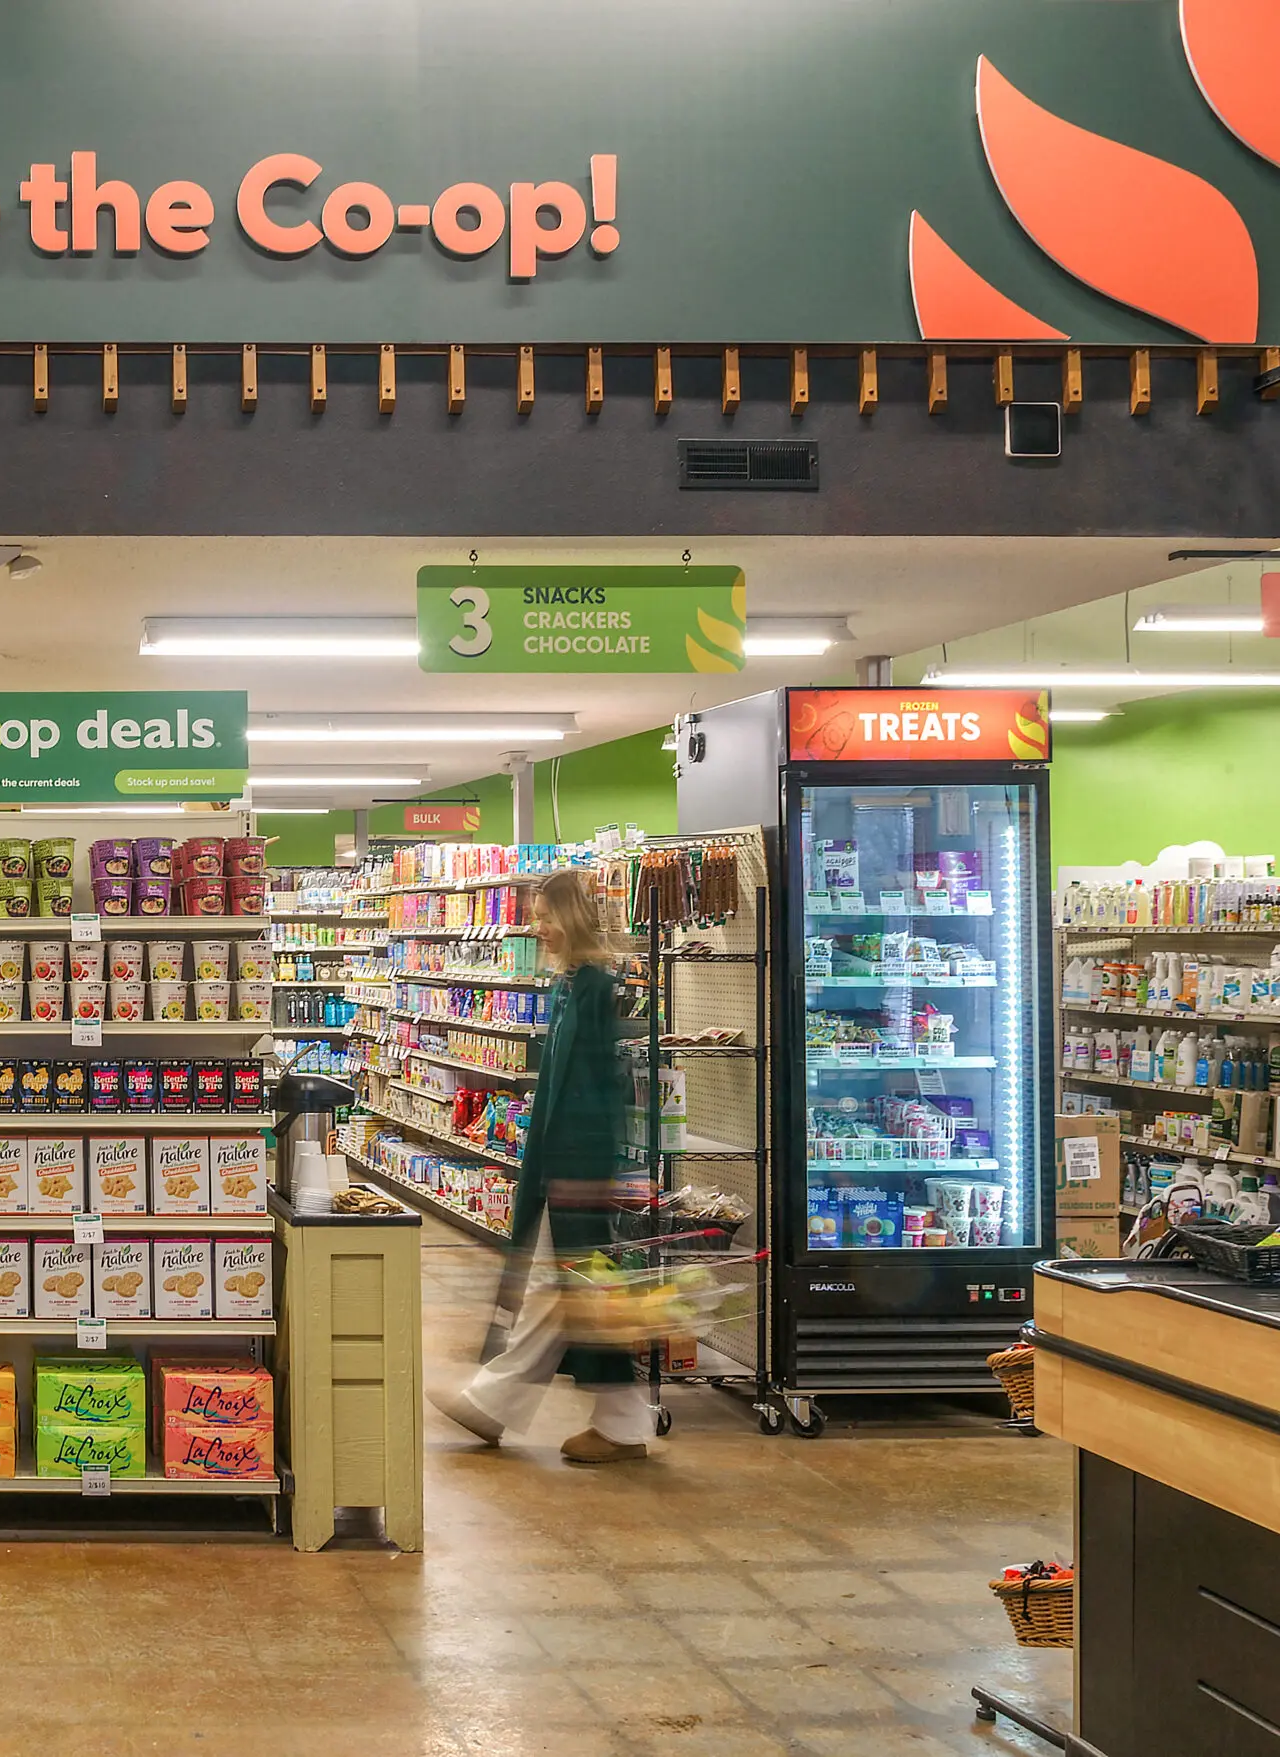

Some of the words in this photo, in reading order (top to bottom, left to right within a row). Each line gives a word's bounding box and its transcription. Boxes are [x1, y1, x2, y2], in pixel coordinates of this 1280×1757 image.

[20, 150, 216, 253] the
[236, 152, 620, 278] Co-op!
[523, 587, 606, 605] SNACKS
[448, 586, 493, 657] 3
[523, 611, 632, 629] CRACKERS
[523, 636, 650, 654] CHOCOLATE
[900, 702, 939, 711] FROZEN
[859, 713, 981, 741] TREATS
[1, 777, 16, 788] the
[18, 778, 53, 788] current
[54, 777, 80, 788] deals
[127, 777, 154, 787] Stock
[155, 779, 168, 789] up
[169, 777, 188, 787] and
[190, 777, 215, 787] save!
[413, 813, 441, 824] BULK
[94, 1075, 119, 1083] Kettle
[128, 1075, 153, 1083] Kettle
[163, 1075, 189, 1083] Kettle
[198, 1075, 224, 1083] Kettle
[234, 1075, 260, 1083] Kettle
[33, 1147, 76, 1164] nature
[96, 1147, 138, 1164] nature
[160, 1147, 202, 1164] nature
[217, 1147, 259, 1164] nature
[42, 1251, 84, 1269] nature
[100, 1250, 143, 1268] nature
[162, 1250, 204, 1268] nature
[223, 1250, 265, 1268] nature
